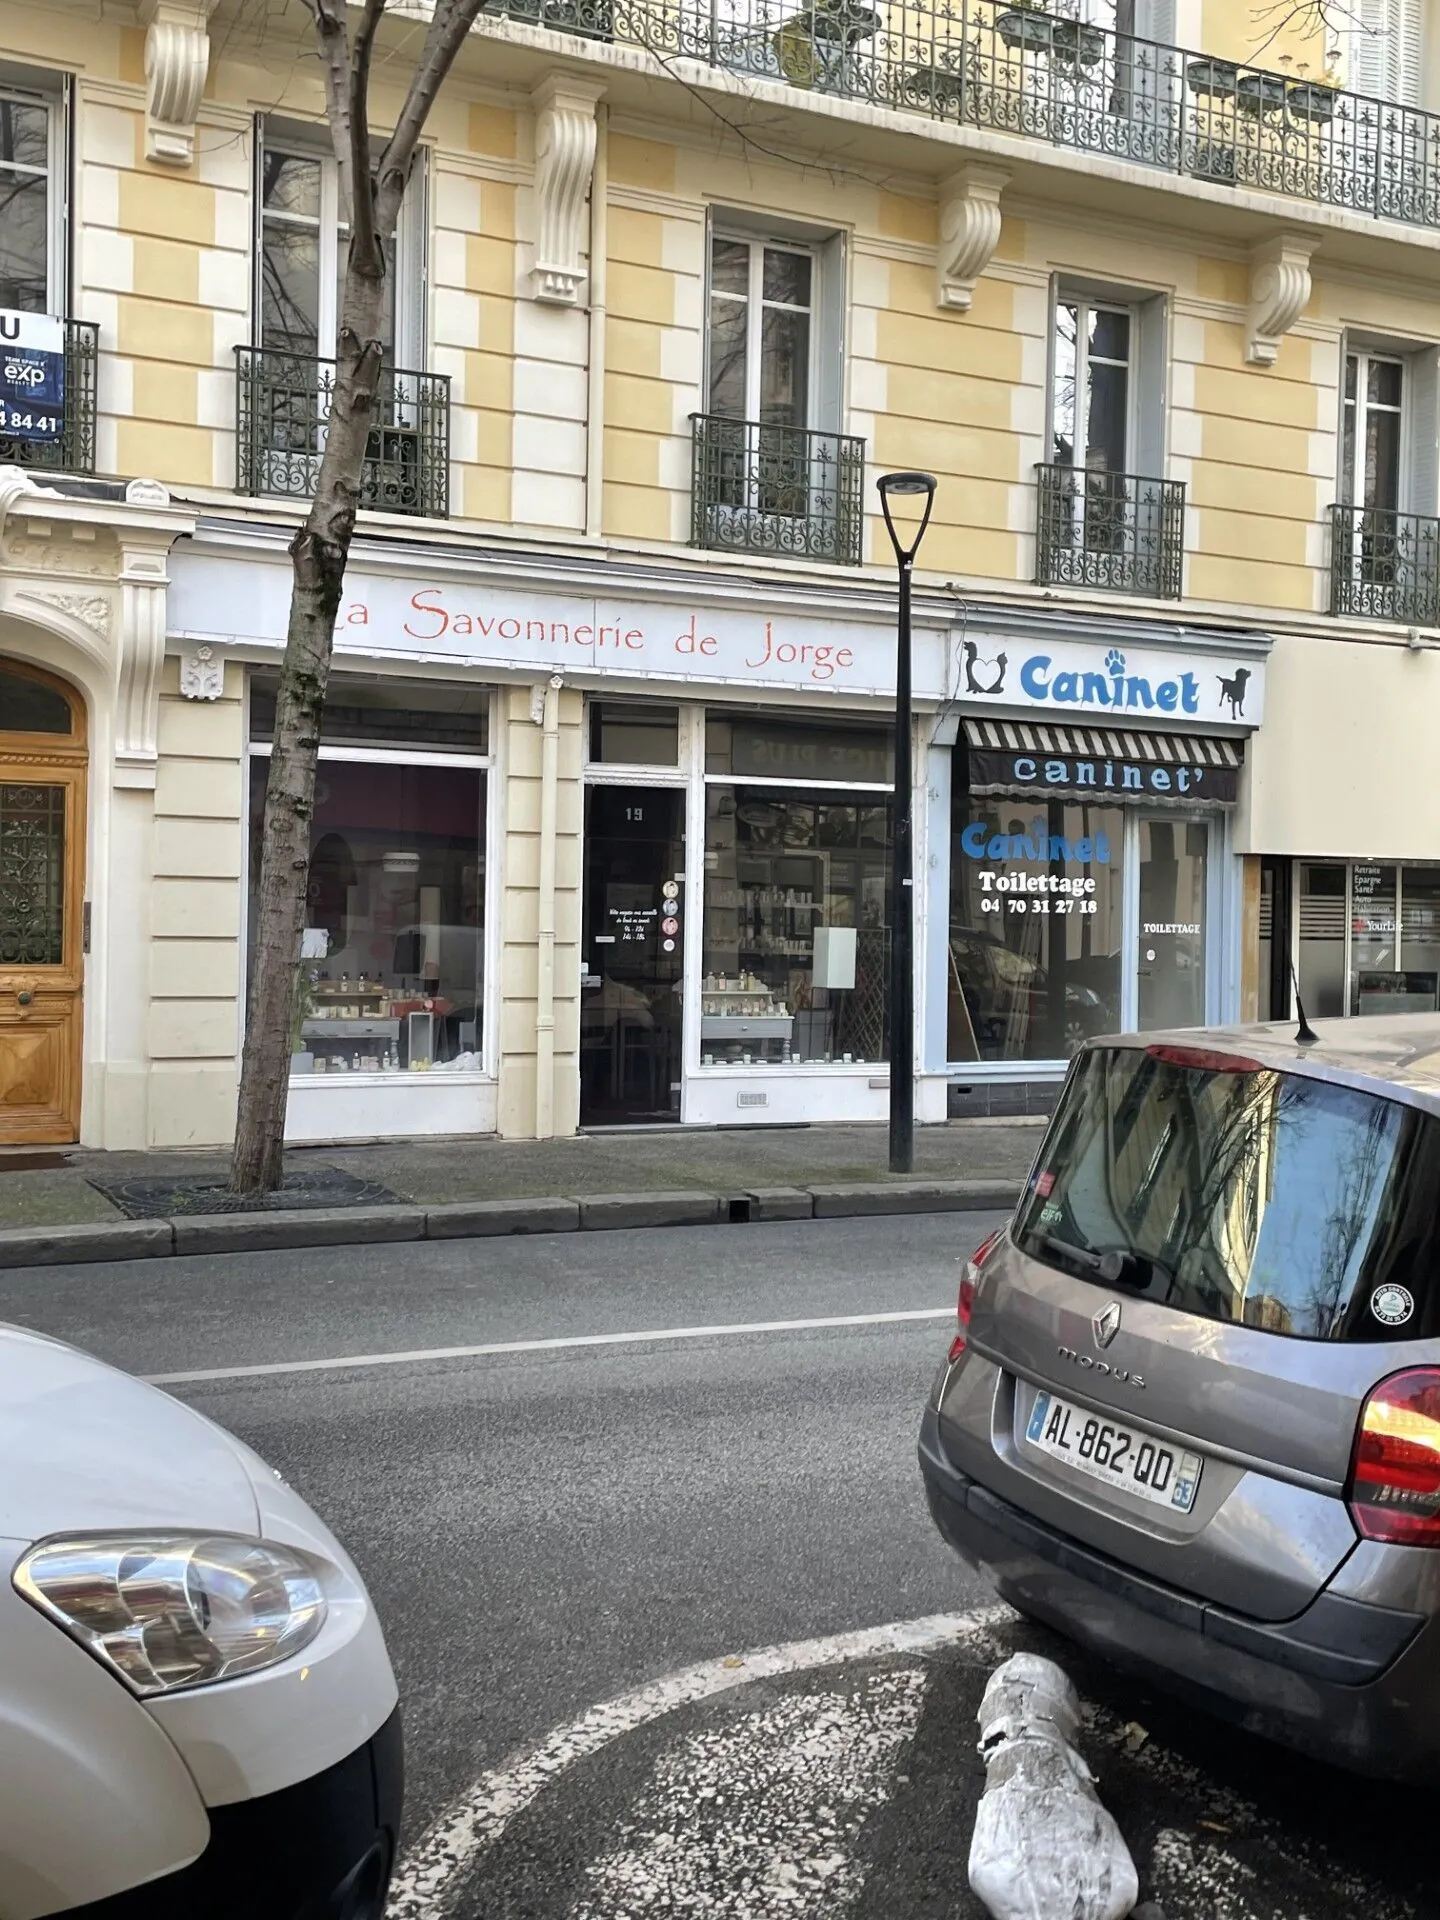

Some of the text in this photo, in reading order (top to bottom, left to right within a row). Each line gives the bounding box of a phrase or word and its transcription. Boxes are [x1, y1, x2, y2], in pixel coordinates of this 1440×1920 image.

[0, 315, 20, 340] U
[11, 412, 32, 430] 84
[36, 416, 56, 432] 41
[333, 589, 853, 680] a Savonnerie de Jorge
[1020, 650, 1199, 713] Caninet
[626, 807, 643, 820] 19
[961, 815, 1111, 864] Caninet
[978, 871, 1096, 896] Toilettage
[981, 898, 1097, 914] 04 70 31 27 18
[1143, 923, 1200, 934] TOILETTAGE
[1045, 1404, 1174, 1491] AL-862-QD
